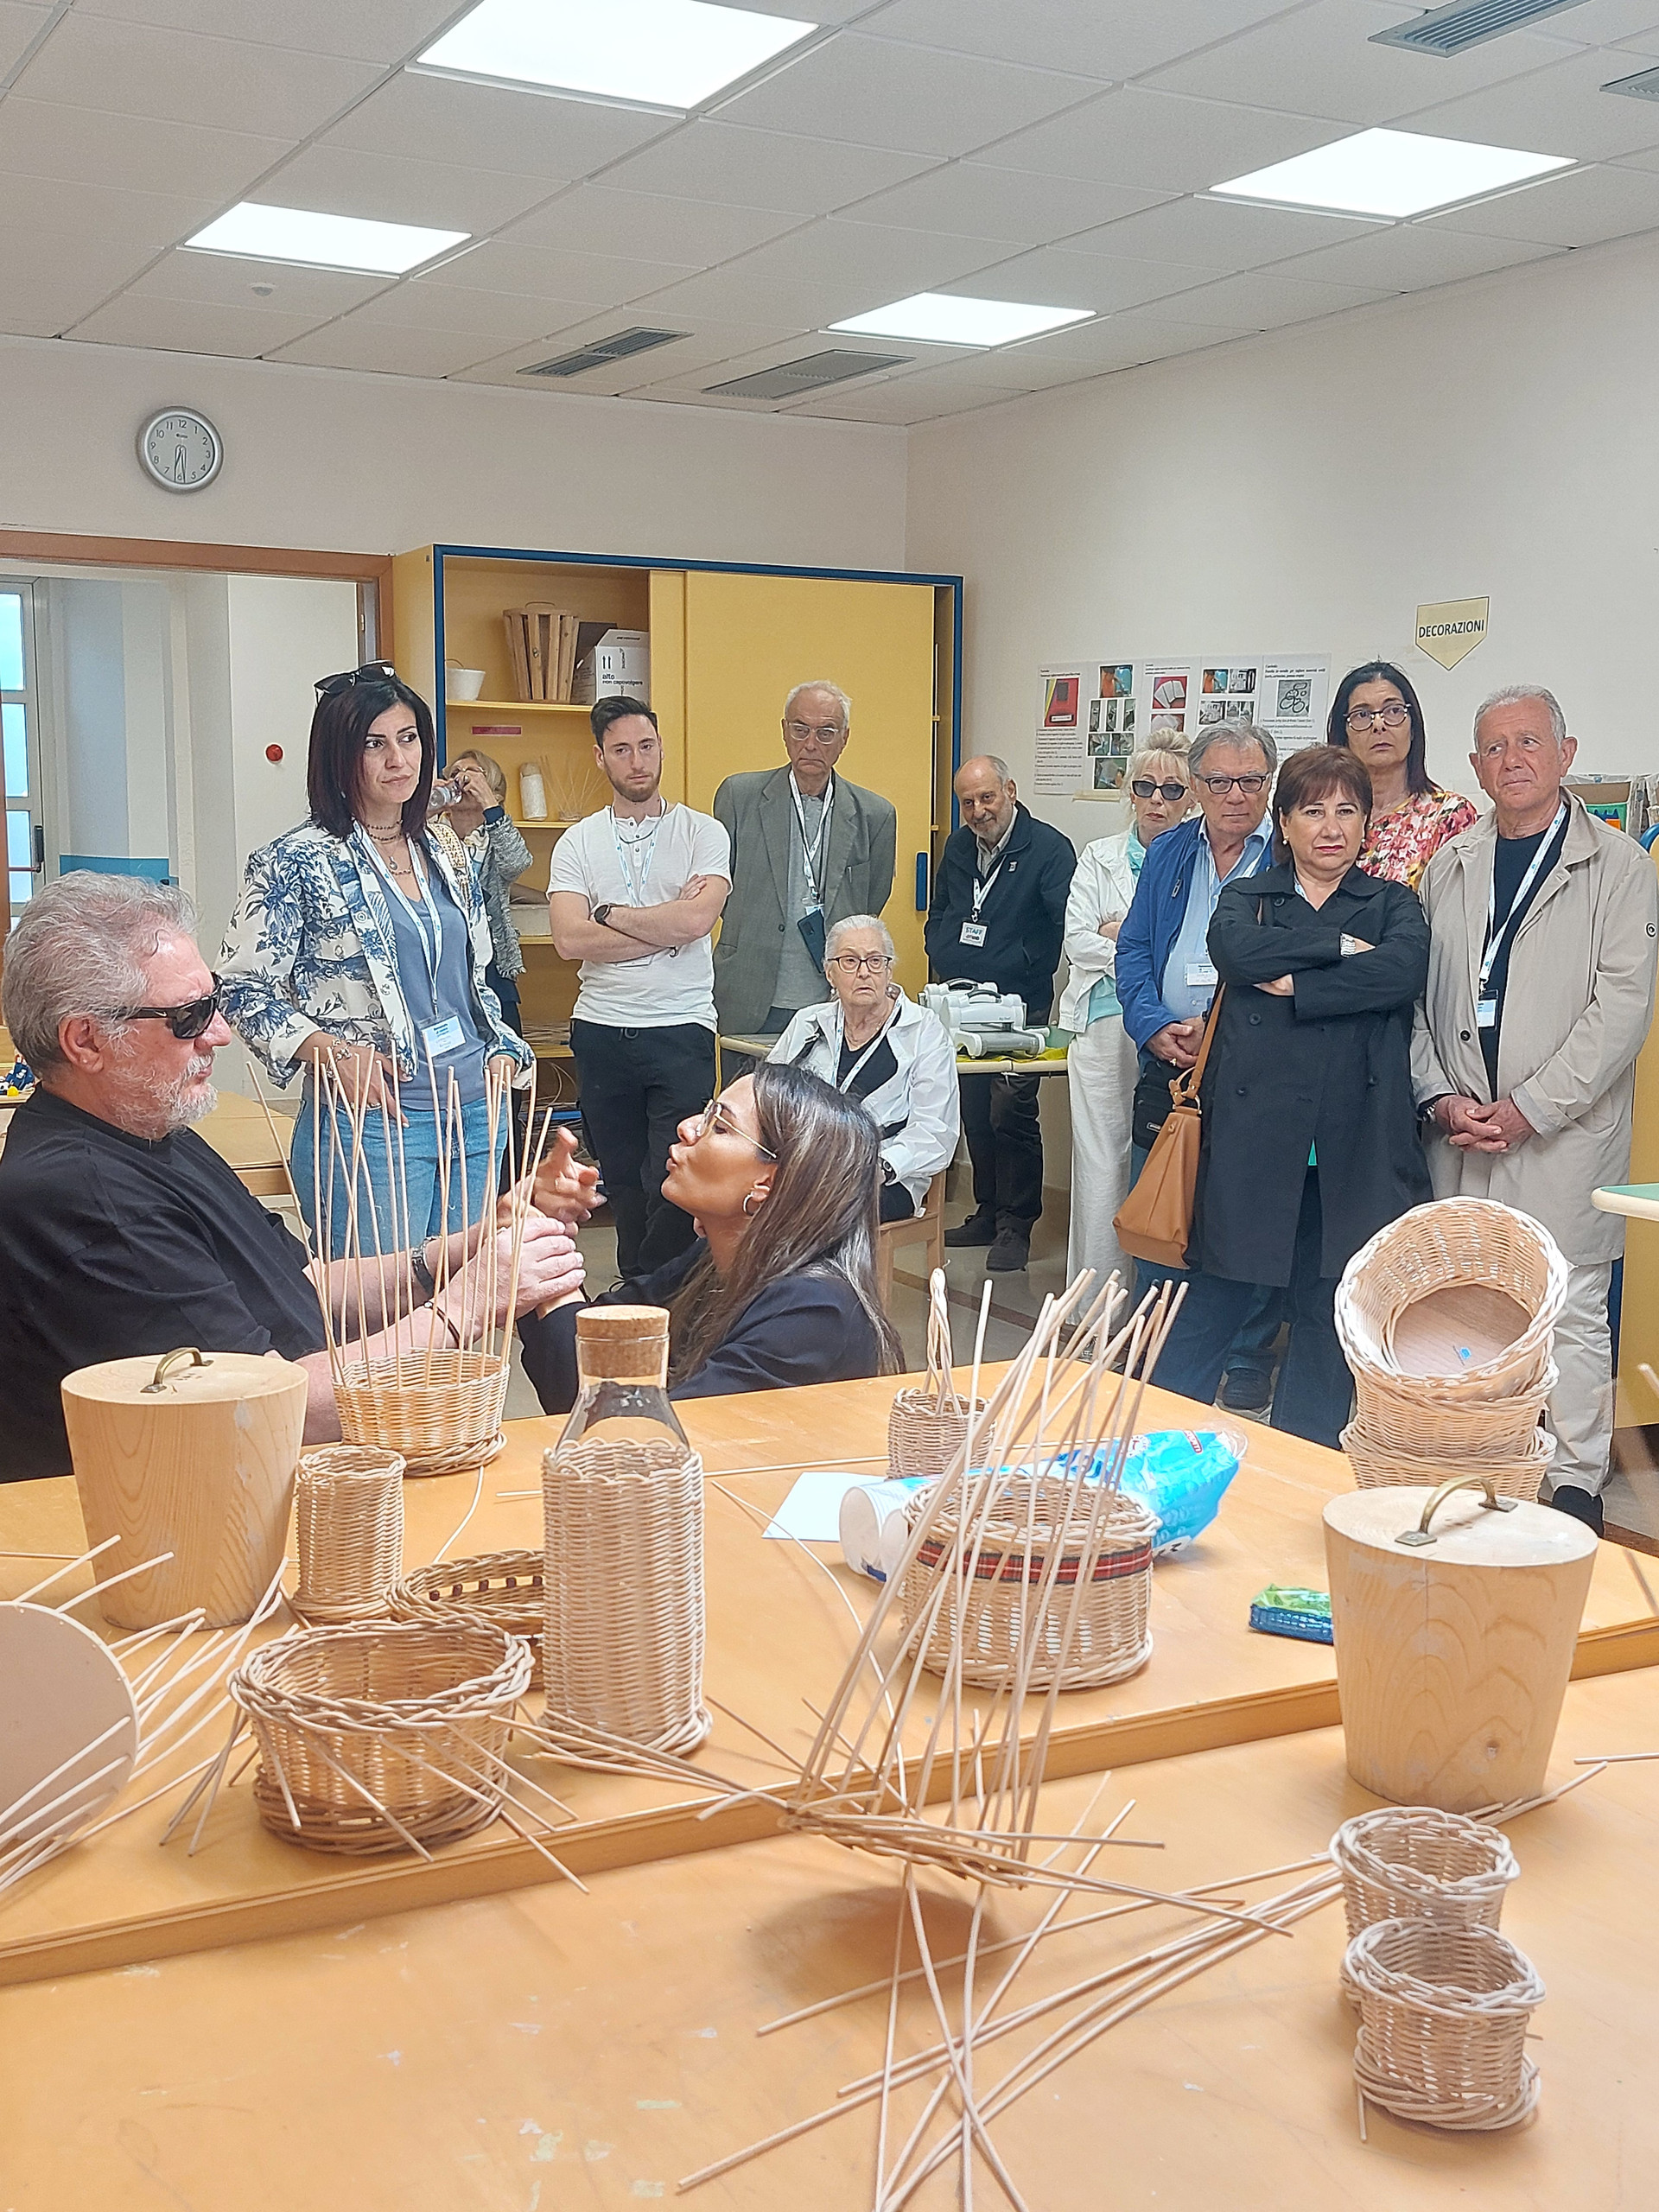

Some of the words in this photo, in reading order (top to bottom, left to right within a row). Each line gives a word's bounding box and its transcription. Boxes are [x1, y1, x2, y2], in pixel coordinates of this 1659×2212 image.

[166, 421, 173, 430] 11
[178, 419, 187, 429] 12
[156, 429, 164, 438] 10
[154, 455, 159, 464] 8
[1419, 620, 1484, 638] DECORAZIONI
